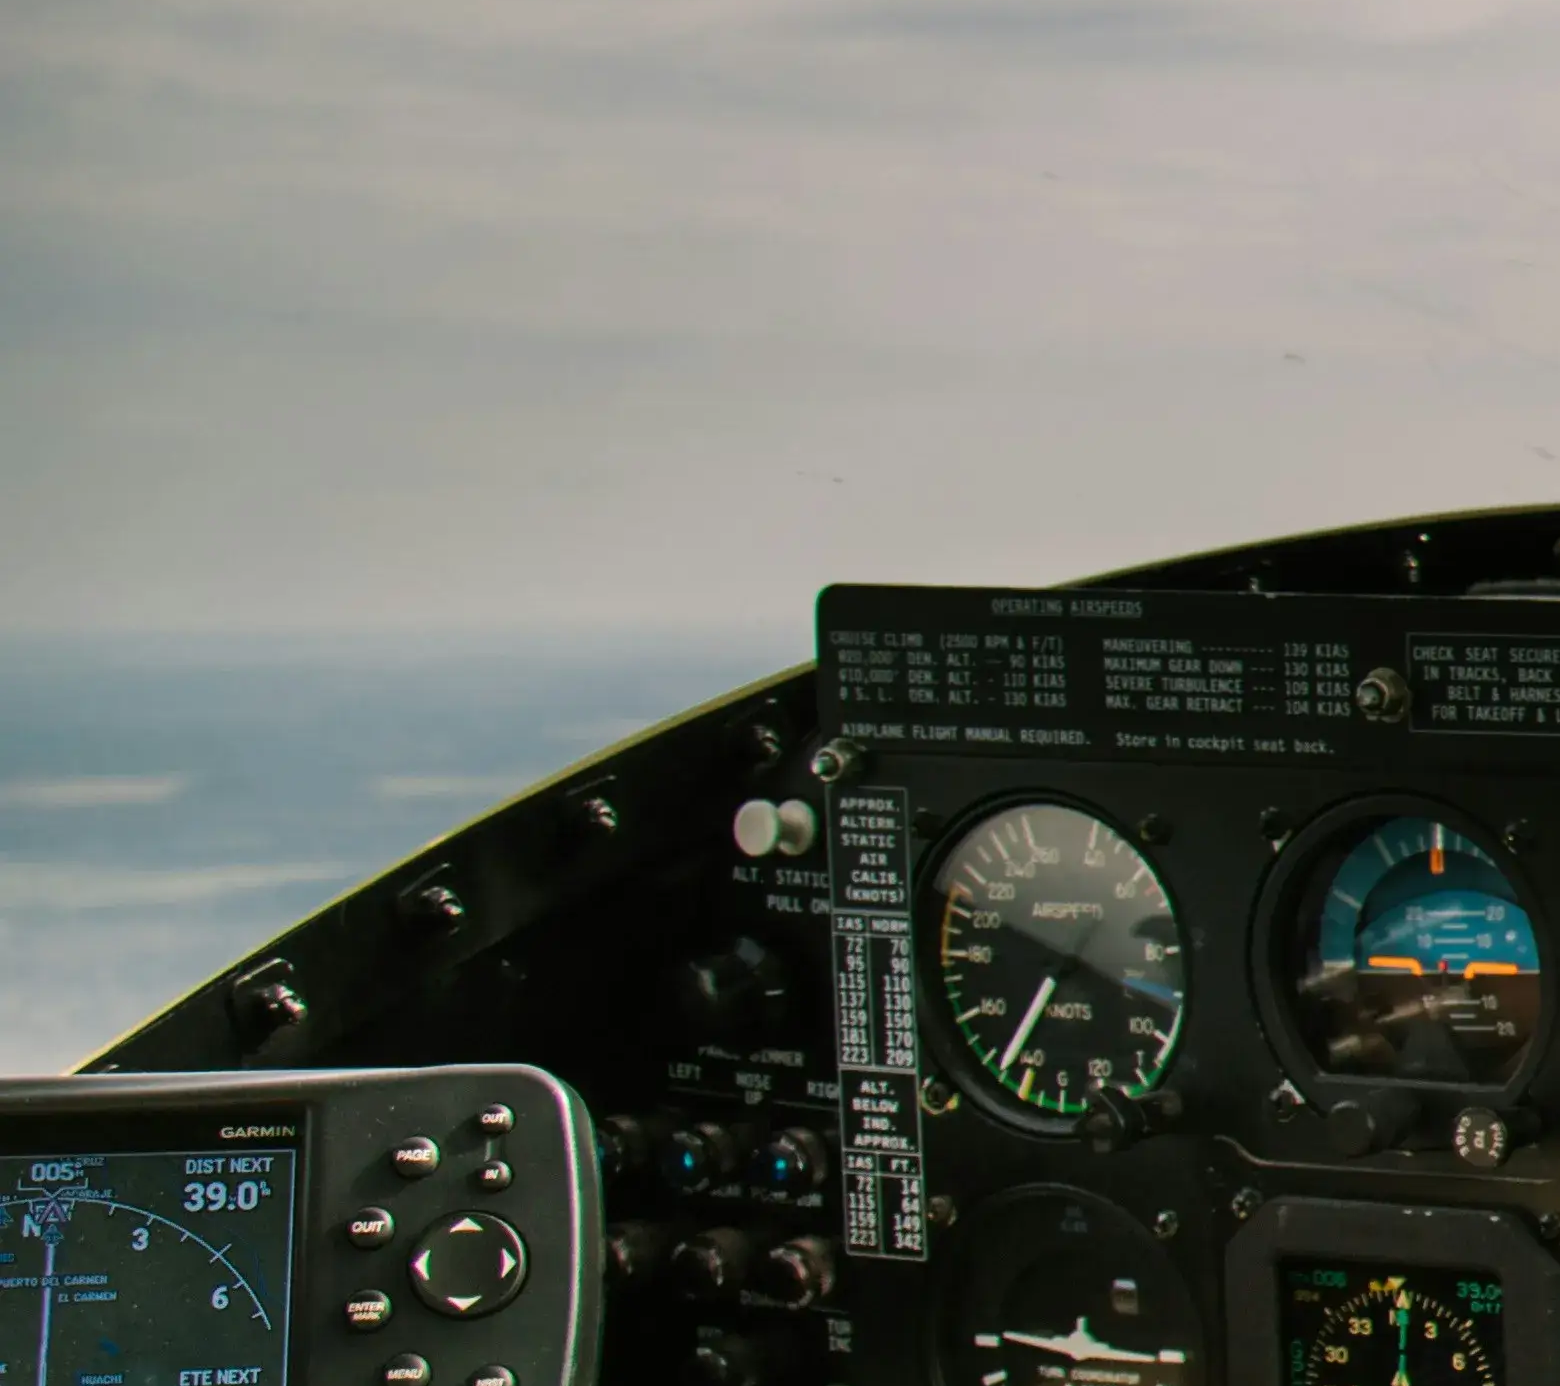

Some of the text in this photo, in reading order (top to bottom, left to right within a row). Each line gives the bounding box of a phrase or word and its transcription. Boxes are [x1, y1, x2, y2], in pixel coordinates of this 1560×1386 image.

[1413, 647, 1455, 661] CHECK
[1465, 647, 1498, 662] SEAT
[1448, 687, 1482, 702] BELT
[1492, 687, 1500, 701] &
[1045, 1003, 1092, 1021] KNOTS
[1129, 1016, 1155, 1035] 100
[1088, 1059, 1111, 1077] 120
[220, 1124, 295, 1139] GARMIN
[397, 1149, 432, 1163] PAGE
[185, 1157, 273, 1174] DIST NEXT
[352, 1219, 384, 1234] QUIT
[180, 1368, 260, 1386] ETE NEXT
[386, 1368, 424, 1382] MENU
